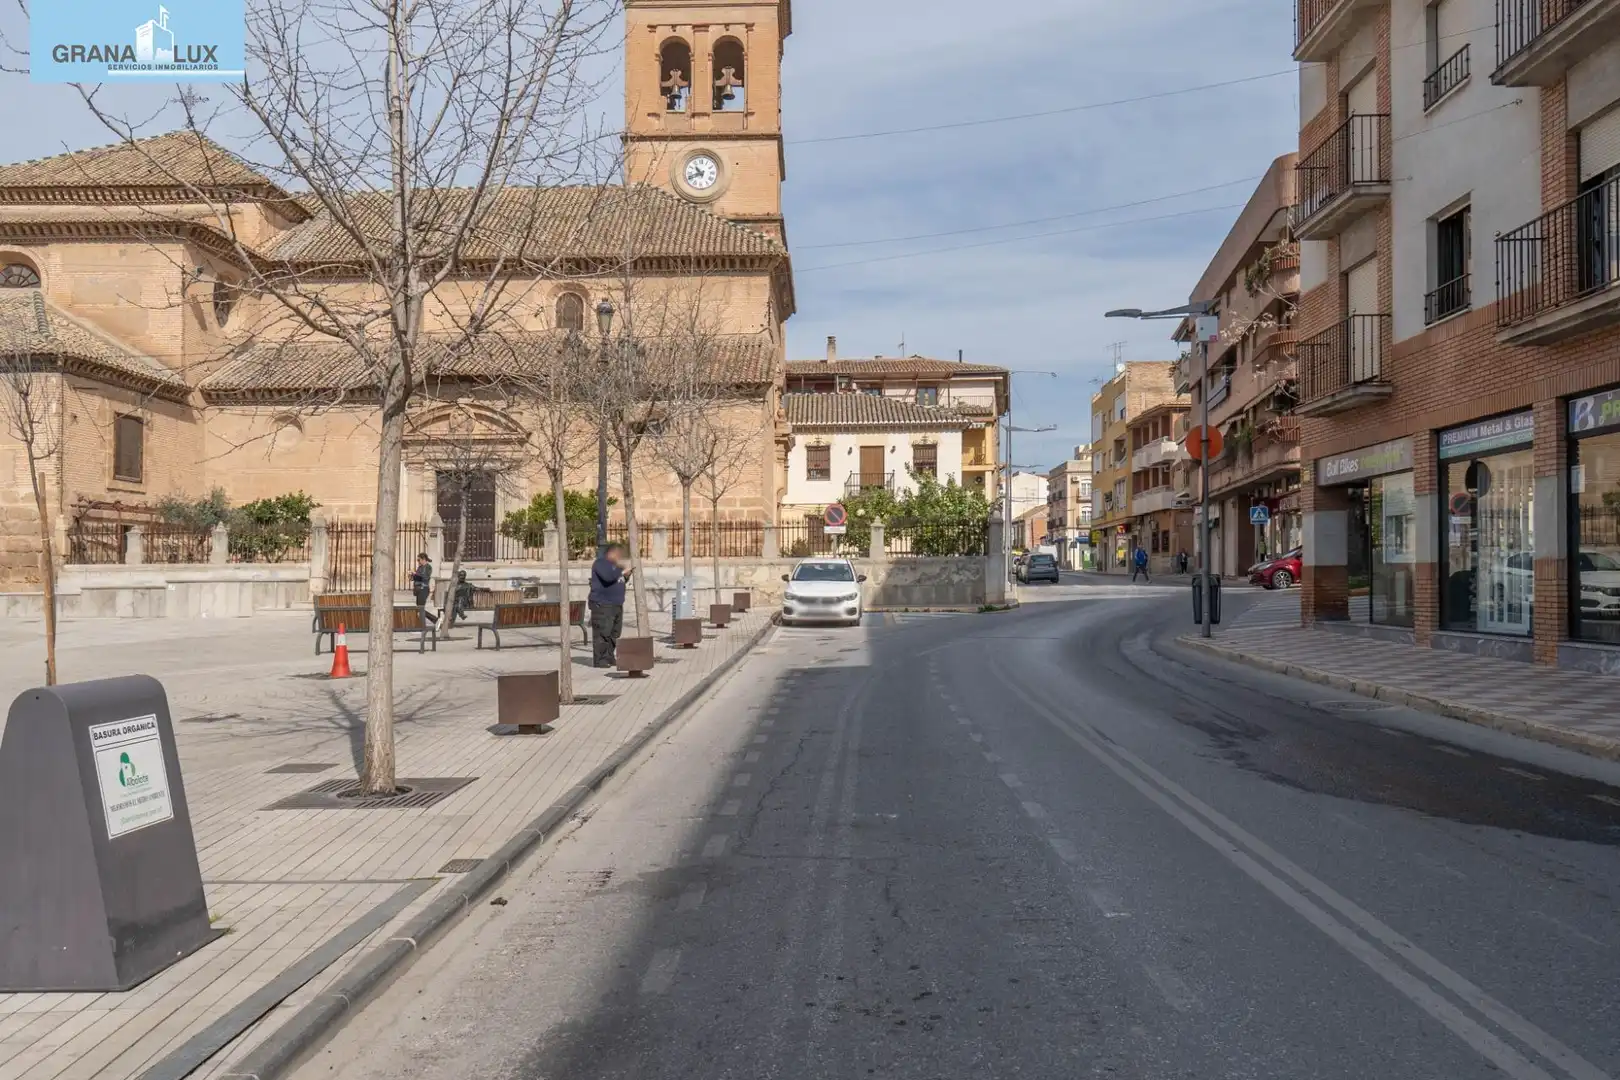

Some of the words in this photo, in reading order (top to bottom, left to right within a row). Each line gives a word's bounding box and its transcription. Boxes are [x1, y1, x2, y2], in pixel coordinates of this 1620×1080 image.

[1442, 427, 1478, 445] PREMIUM
[1481, 421, 1503, 436] Metal
[93, 729, 121, 740] BASURA
[122, 722, 155, 734] ORGANICA
